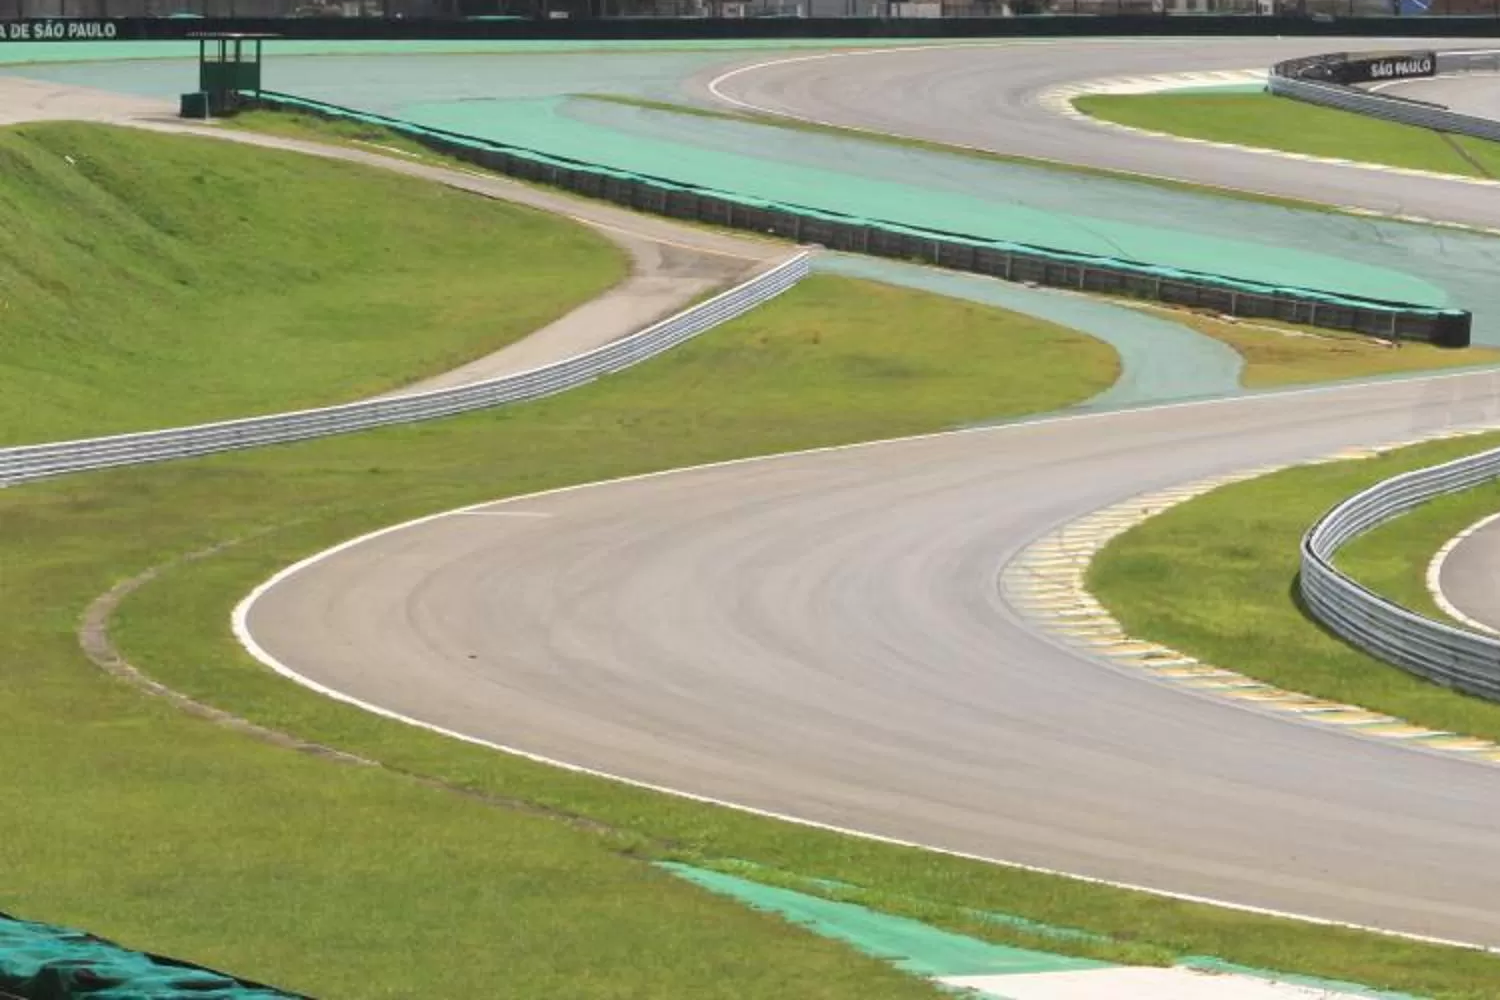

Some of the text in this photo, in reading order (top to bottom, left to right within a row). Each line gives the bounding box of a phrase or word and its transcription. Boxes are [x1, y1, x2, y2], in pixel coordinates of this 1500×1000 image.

[10, 23, 30, 39] DE
[33, 19, 64, 39] SÃO
[68, 22, 116, 38] PAULO
[1370, 59, 1431, 77] SÃO PAULO
